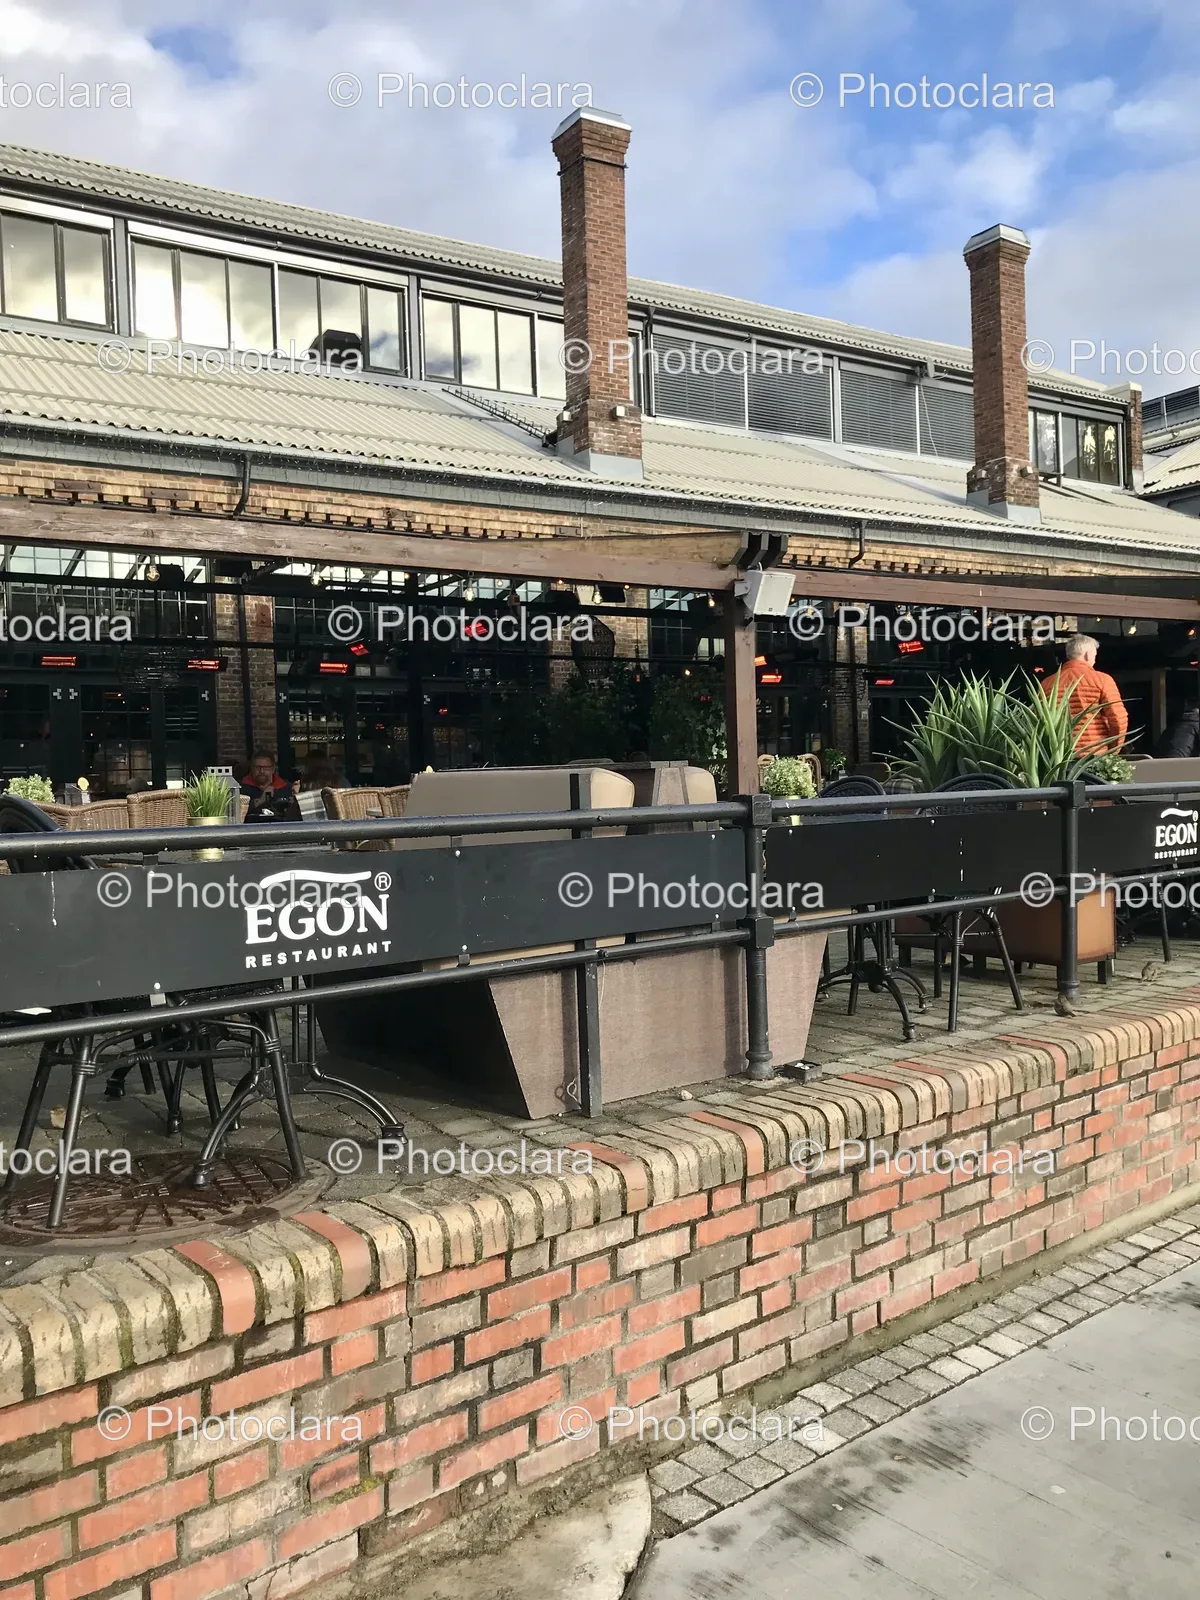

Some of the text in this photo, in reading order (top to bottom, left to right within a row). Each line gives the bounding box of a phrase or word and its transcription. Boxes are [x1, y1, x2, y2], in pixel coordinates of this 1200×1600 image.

[1155, 822, 1198, 847] EGON
[1154, 847, 1198, 860] RESTAURANT
[244, 894, 390, 945] EGON
[245, 941, 392, 969] RESTAURANT
